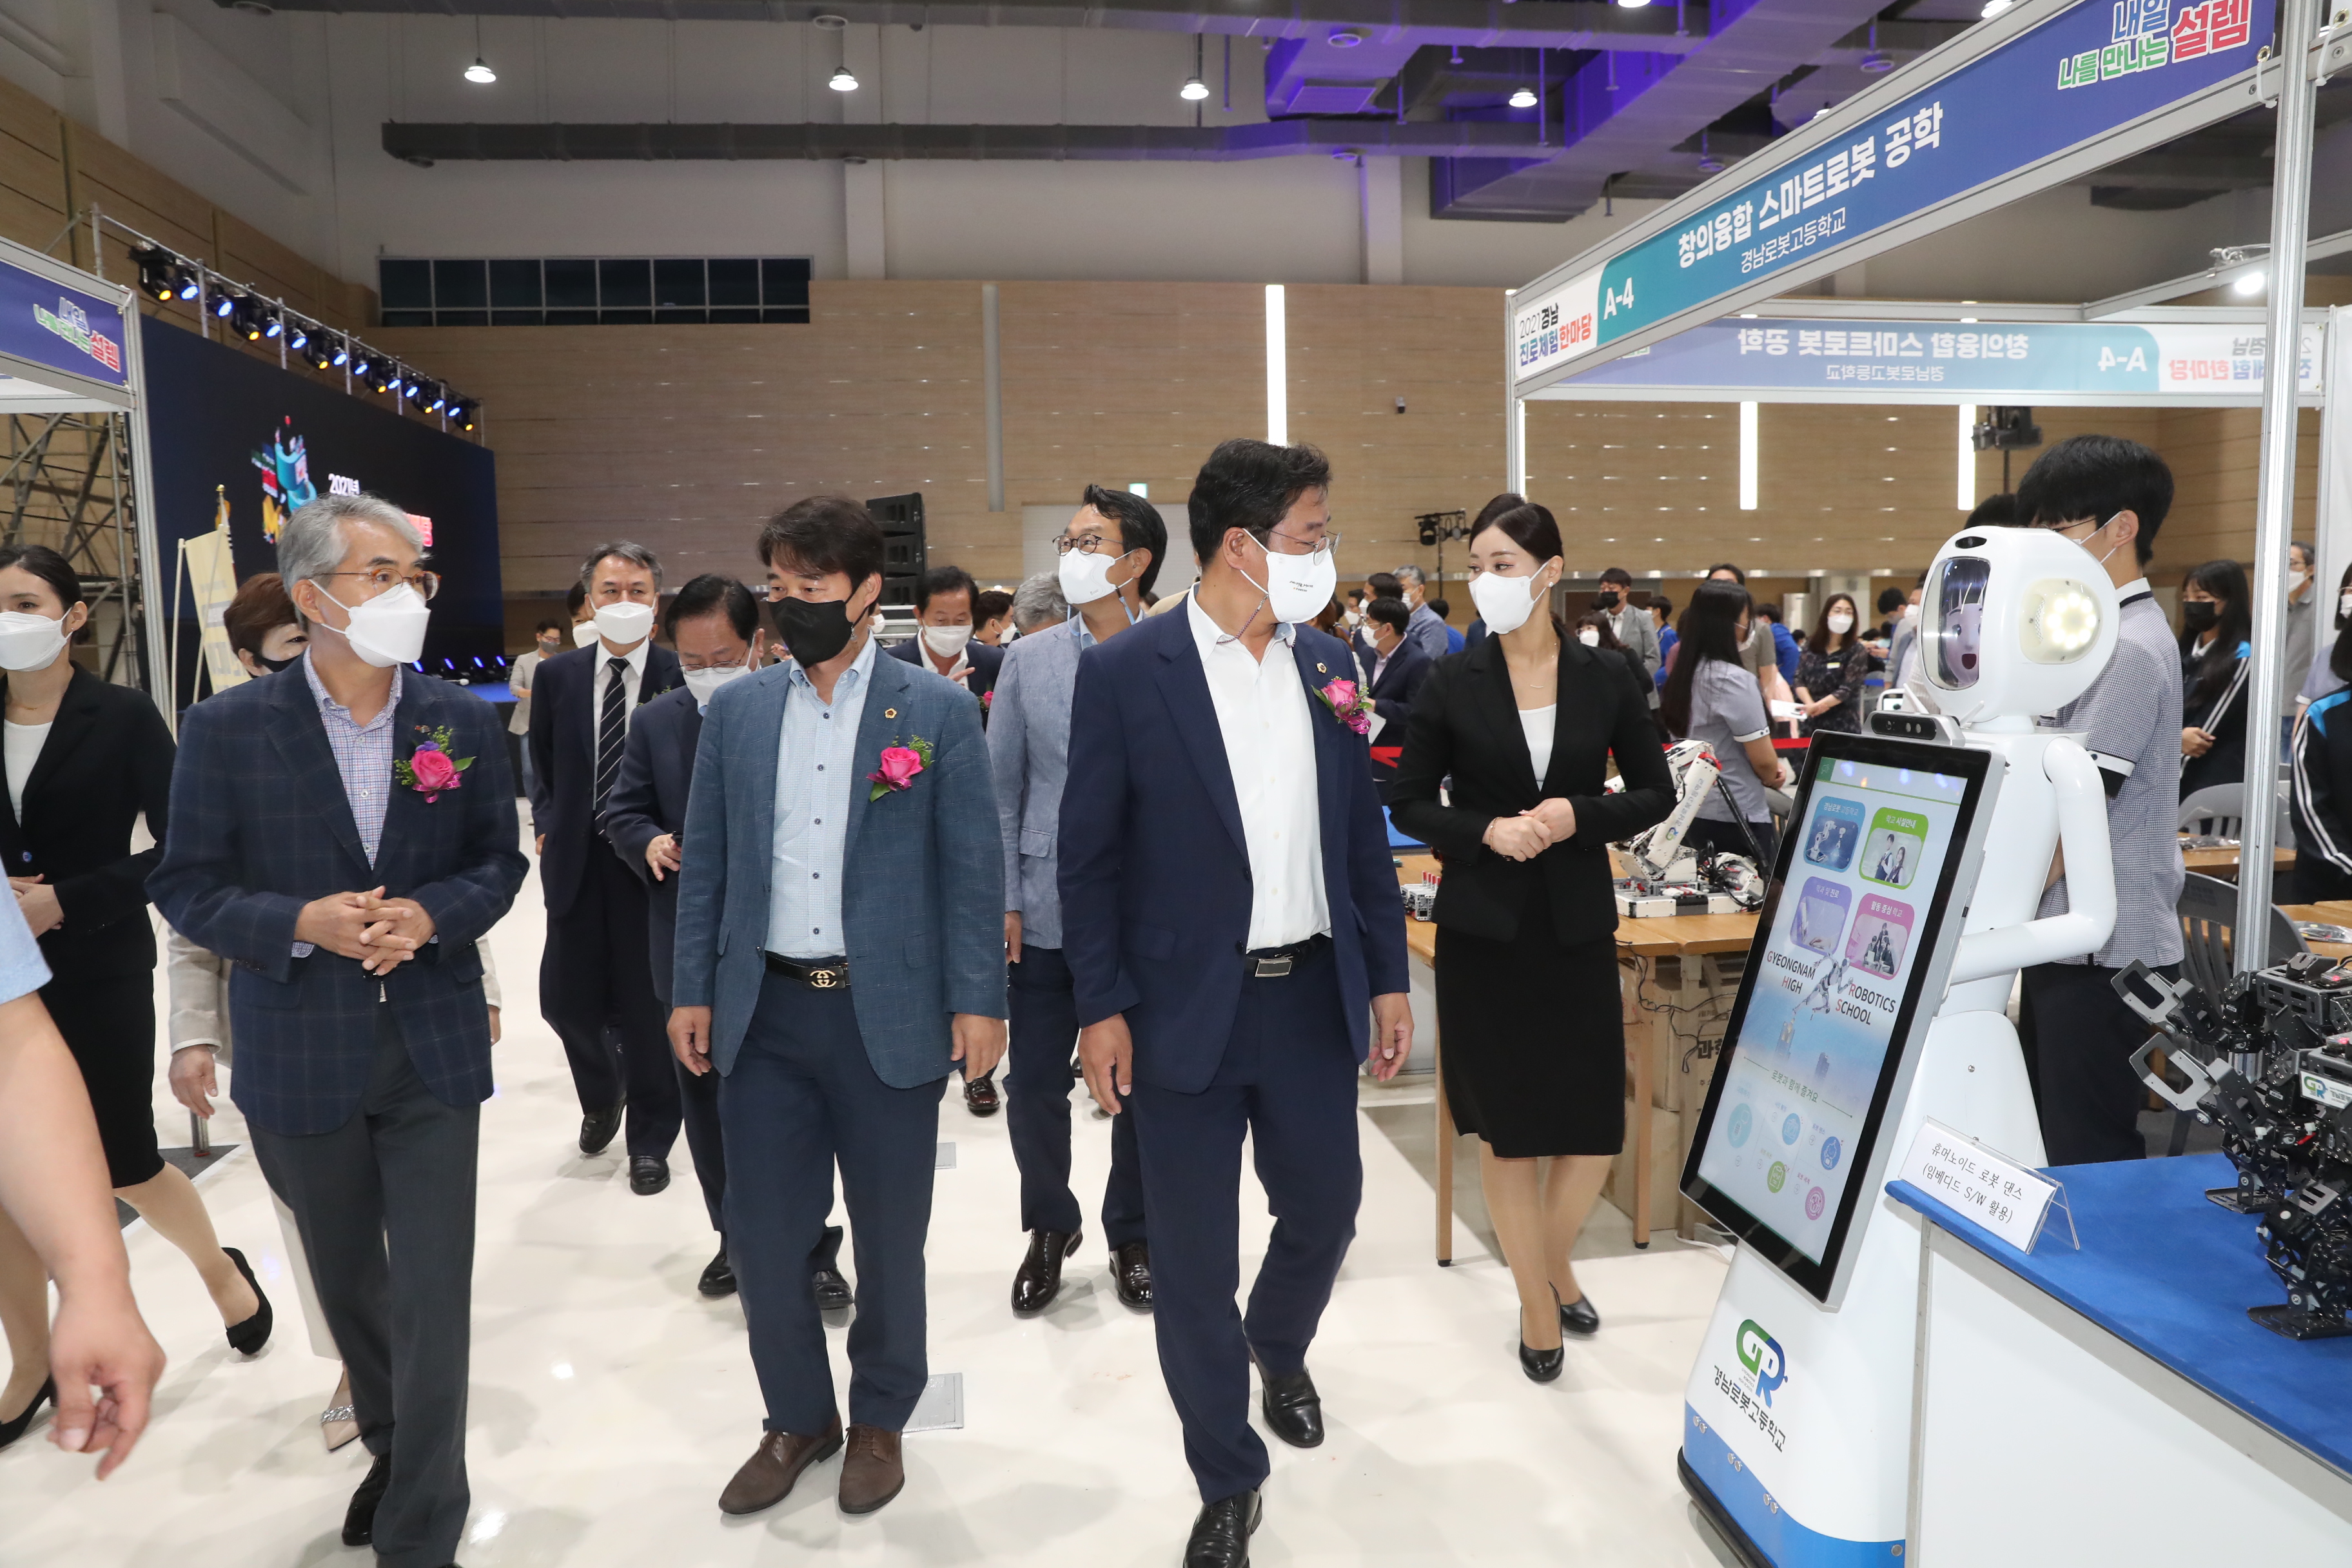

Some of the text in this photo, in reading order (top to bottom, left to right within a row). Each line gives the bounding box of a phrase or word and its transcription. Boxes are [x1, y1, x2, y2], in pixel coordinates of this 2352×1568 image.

[2112, 0, 2170, 43] 내일
[2058, 0, 2251, 90] 나를 만나는 설렘
[1678, 101, 1943, 269] 창의융합 스마트로봇 공학
[1741, 207, 1847, 273] 경남로봇고등학교
[1603, 277, 1635, 320] A-4
[1886, 814, 1917, 828] 학교 시설안내
[1830, 888, 1840, 899] 진로
[1870, 900, 1903, 917] 활동 중심 학교
[1767, 950, 1816, 980] GYEONGNAM
[1781, 975, 1803, 994] HIGH
[1848, 983, 1896, 1013] ROBOTICS
[1836, 999, 1871, 1025] SCHOOL
[1771, 1070, 1819, 1103] 로봇과 함께 즐겨요
[1932, 1142, 2023, 1200] 휴머노이드 로봇 댄스
[1922, 1162, 2014, 1224] (임베디드 S/W 활용)
[1714, 1365, 1787, 1453] 경남로봇고등학교
